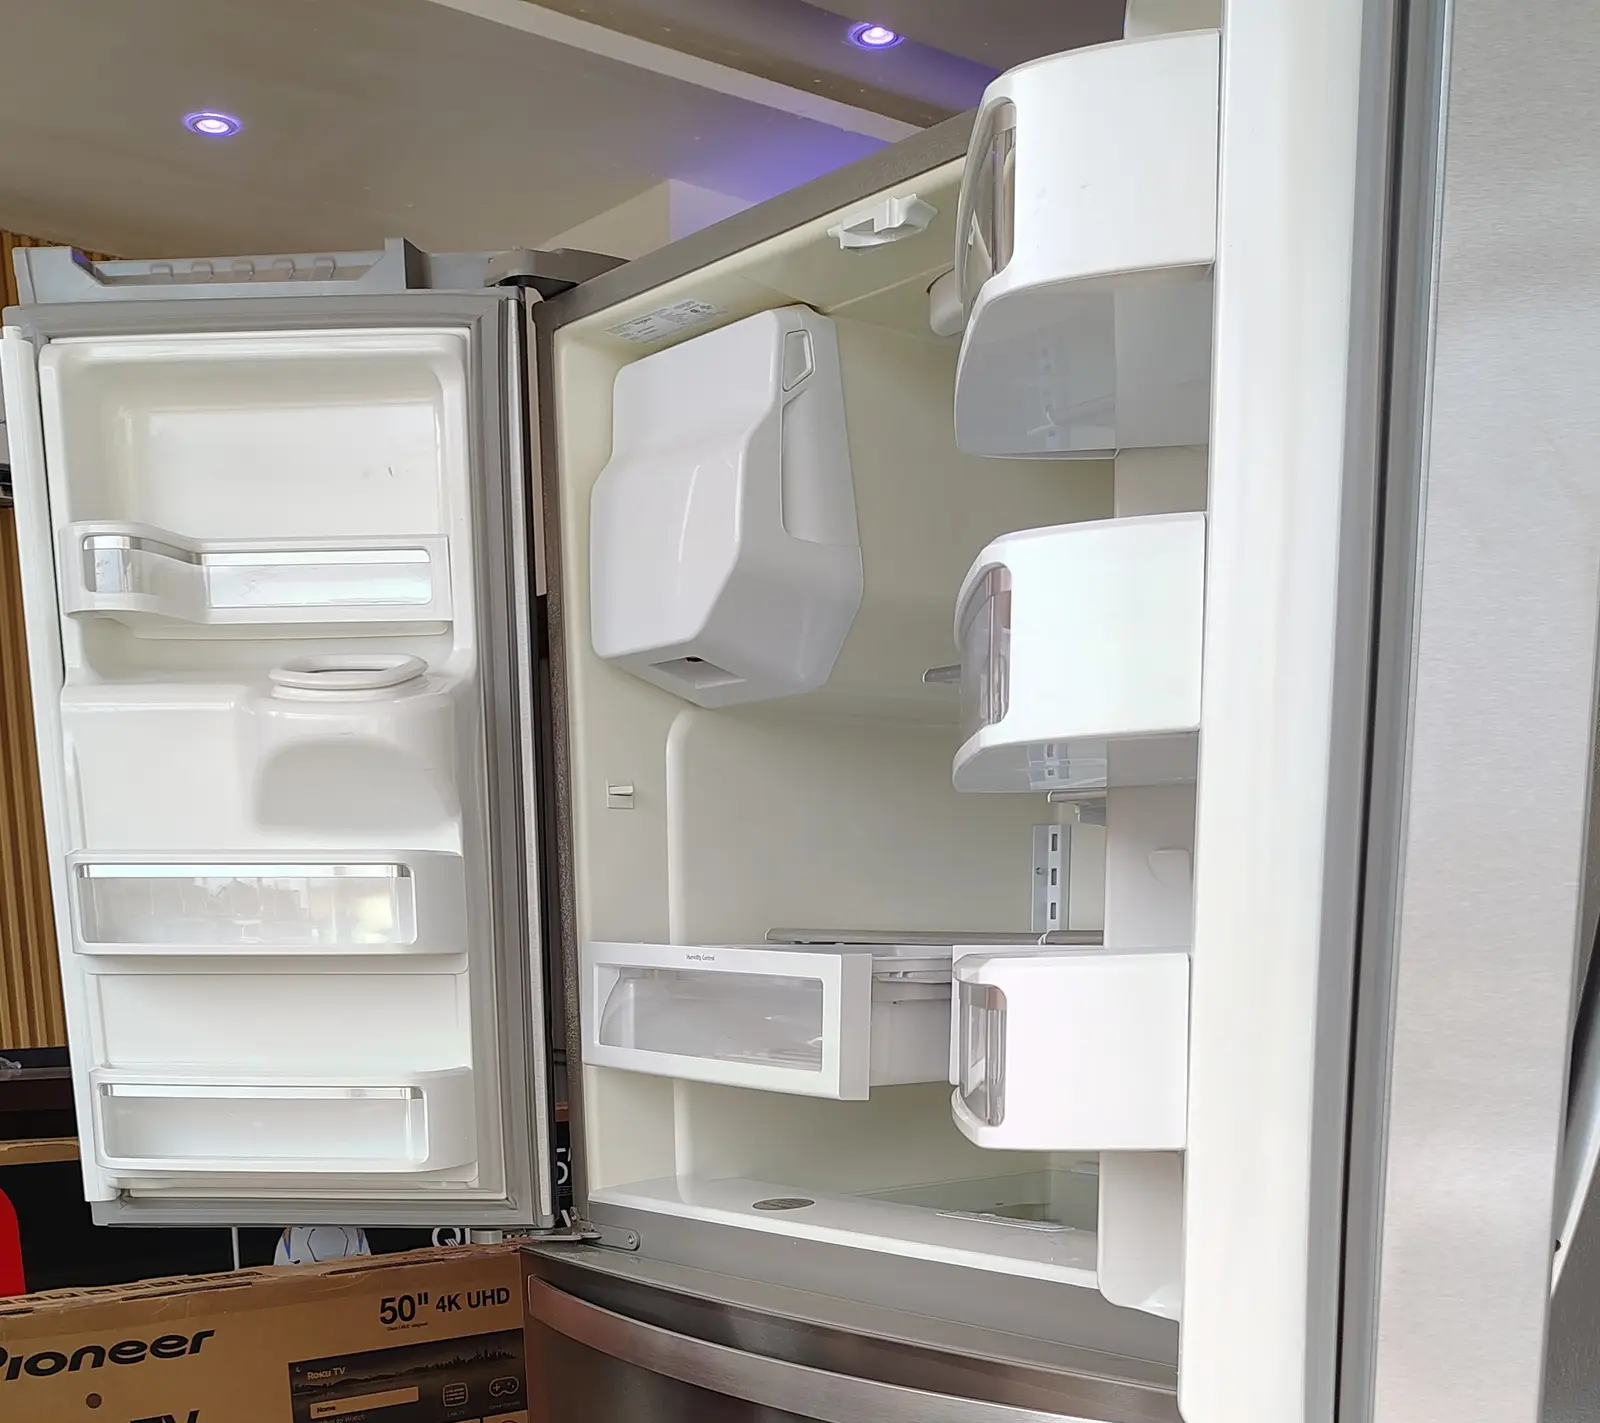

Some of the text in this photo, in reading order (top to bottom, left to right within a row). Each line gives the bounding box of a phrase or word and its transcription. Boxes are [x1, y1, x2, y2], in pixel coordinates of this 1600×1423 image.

[379, 1287, 510, 1325] 50" 4K UHD
[333, 1366, 346, 1376] TV
[316, 1405, 336, 1413] Home
